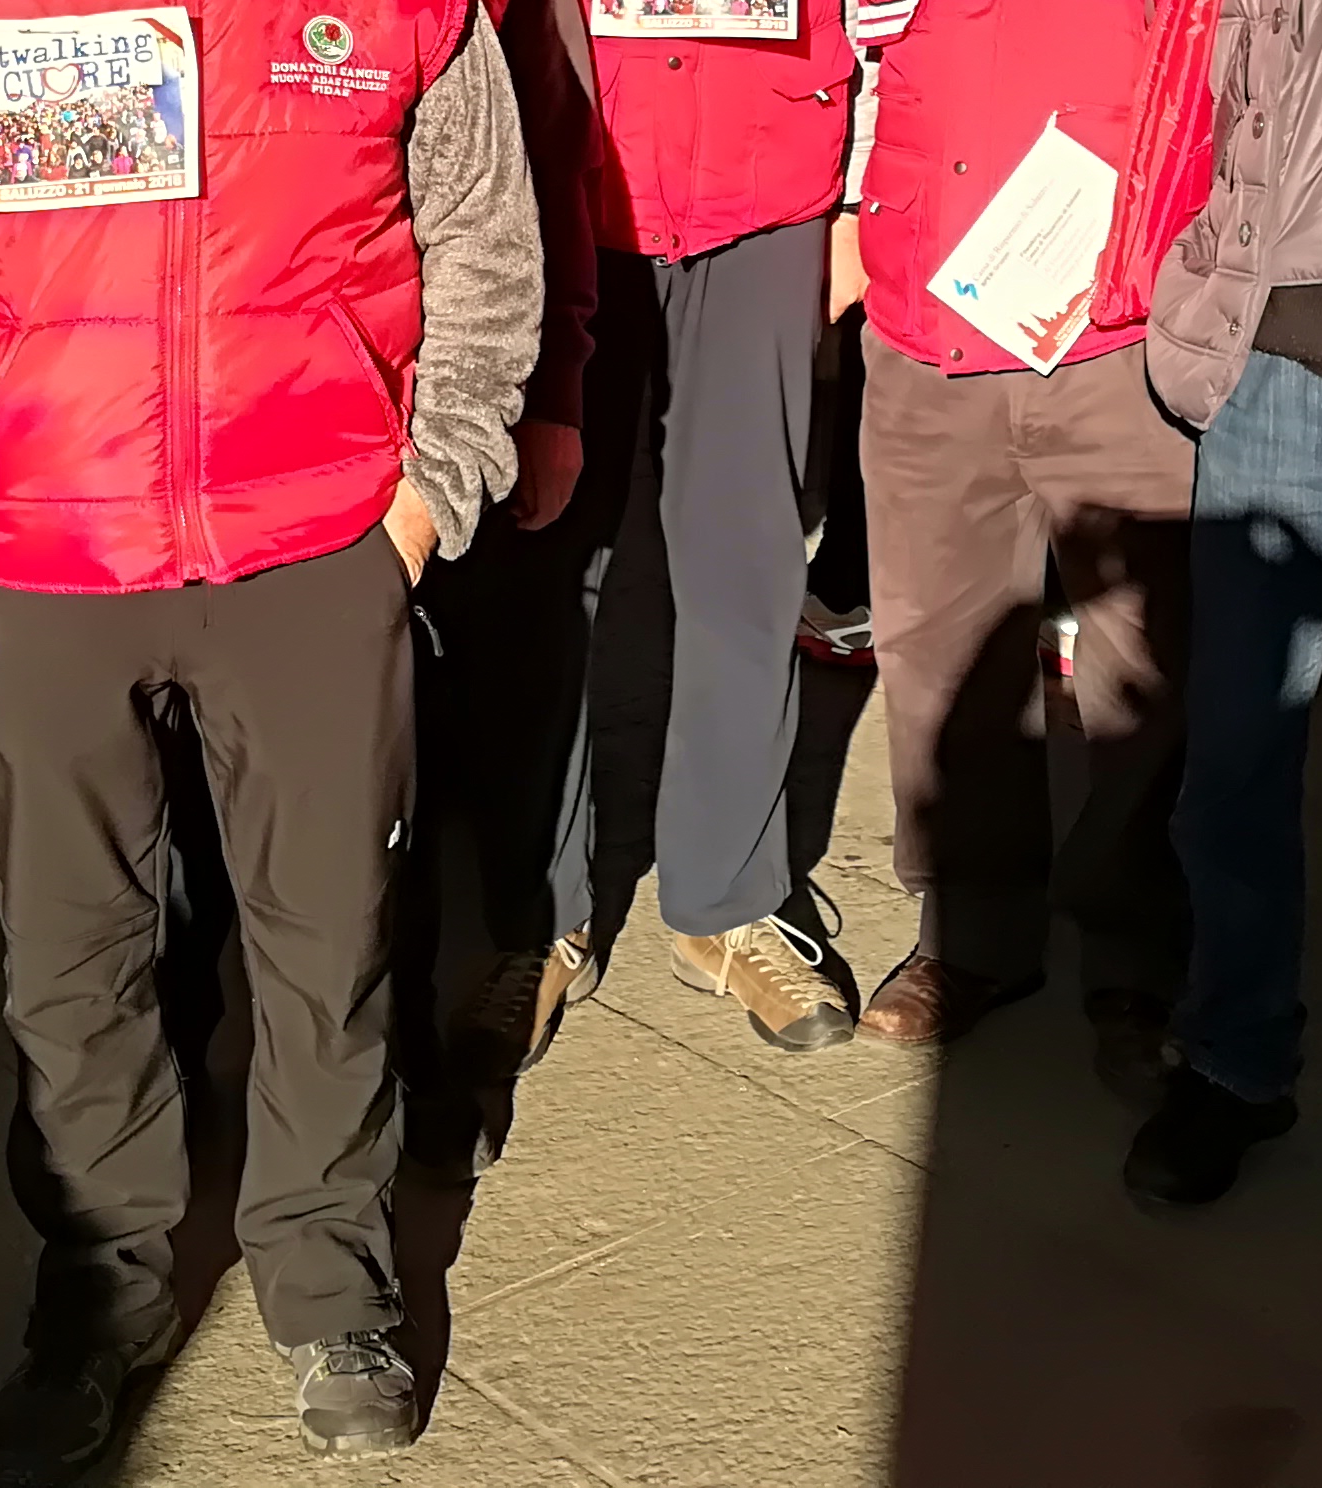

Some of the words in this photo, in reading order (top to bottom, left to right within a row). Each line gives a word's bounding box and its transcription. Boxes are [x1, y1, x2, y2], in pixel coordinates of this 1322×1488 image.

[271, 62, 337, 75] DONATORI
[339, 67, 390, 81] SANGUE
[271, 73, 310, 84] NUOVA
[312, 75, 341, 87] ADAS
[342, 79, 387, 91] SALUZZO
[311, 85, 351, 98] FIDAS
[0, 185, 67, 201] SALUZZO
[74, 183, 90, 196] 21
[148, 174, 183, 189] 2018
